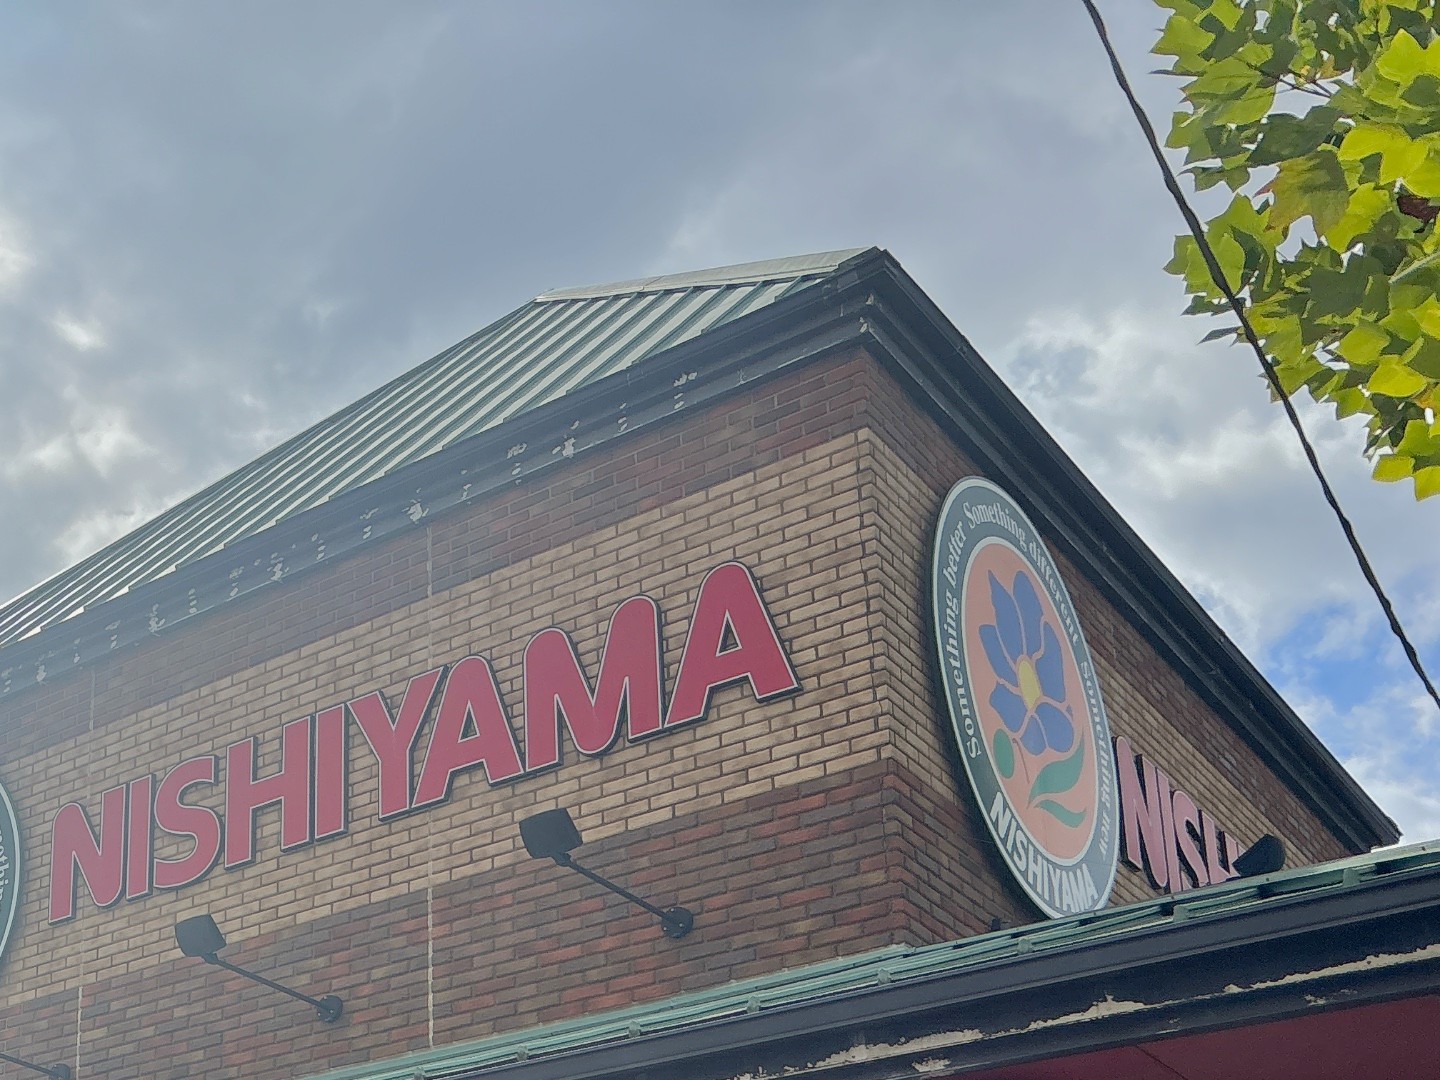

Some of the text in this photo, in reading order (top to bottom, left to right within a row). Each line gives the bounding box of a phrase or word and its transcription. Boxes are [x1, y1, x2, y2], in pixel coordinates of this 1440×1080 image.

[942, 520, 967, 588] better
[963, 501, 1028, 552] Something
[1028, 540, 1079, 646] different
[941, 588, 982, 760] Something
[48, 560, 800, 925] NISHIYAMA
[989, 791, 1099, 913] NISHIYAMA
